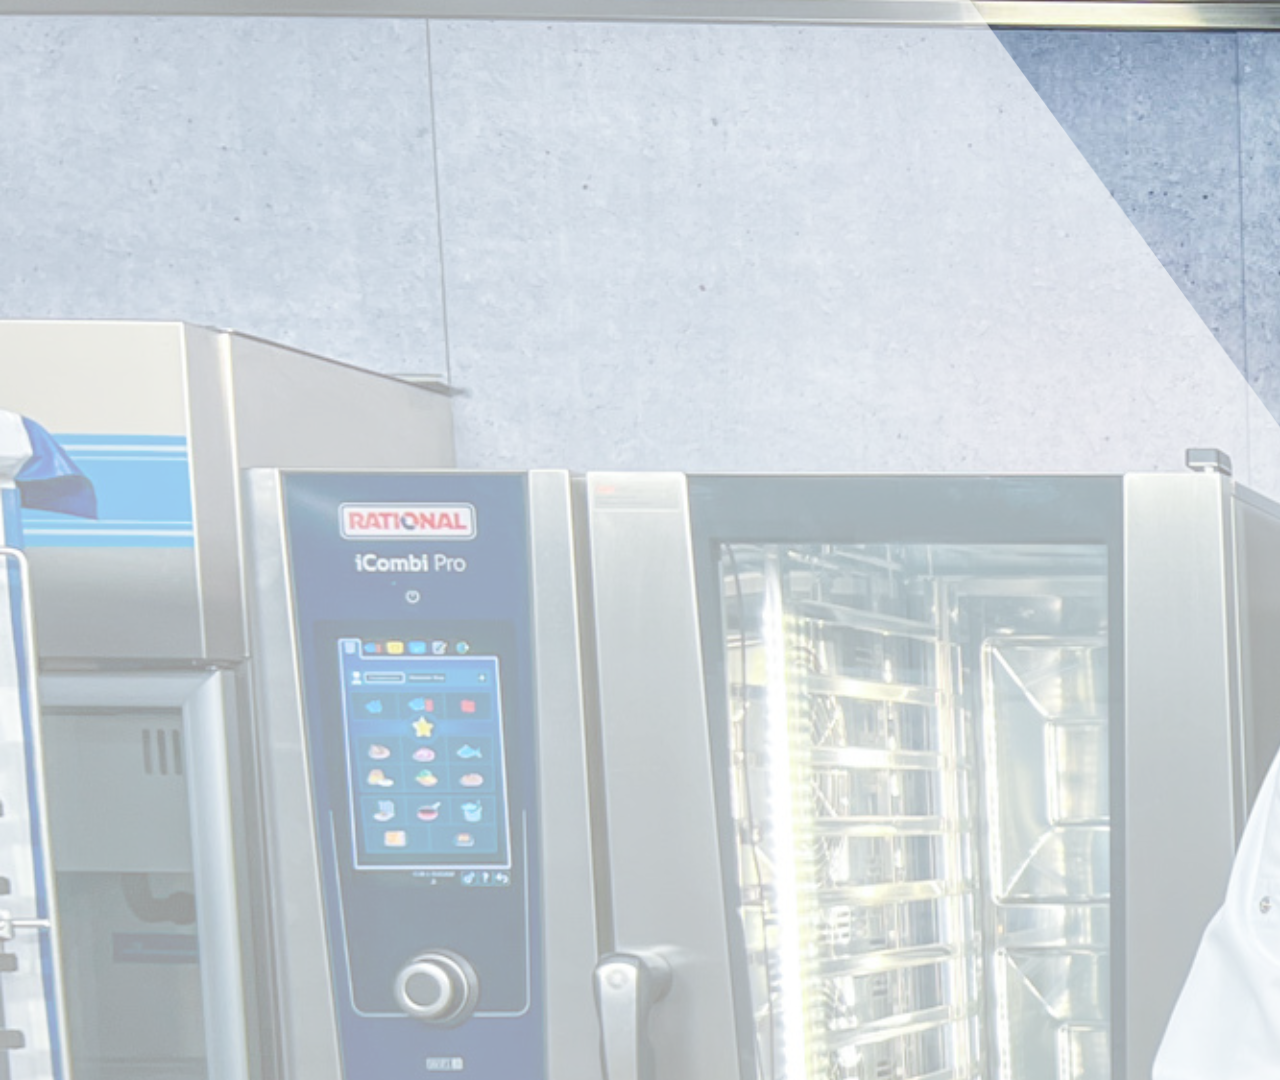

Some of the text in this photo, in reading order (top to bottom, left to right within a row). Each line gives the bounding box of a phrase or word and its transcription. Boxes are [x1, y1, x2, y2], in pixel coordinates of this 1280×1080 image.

[348, 511, 468, 531] RATIONAL
[354, 553, 467, 573] iCombi Pro
